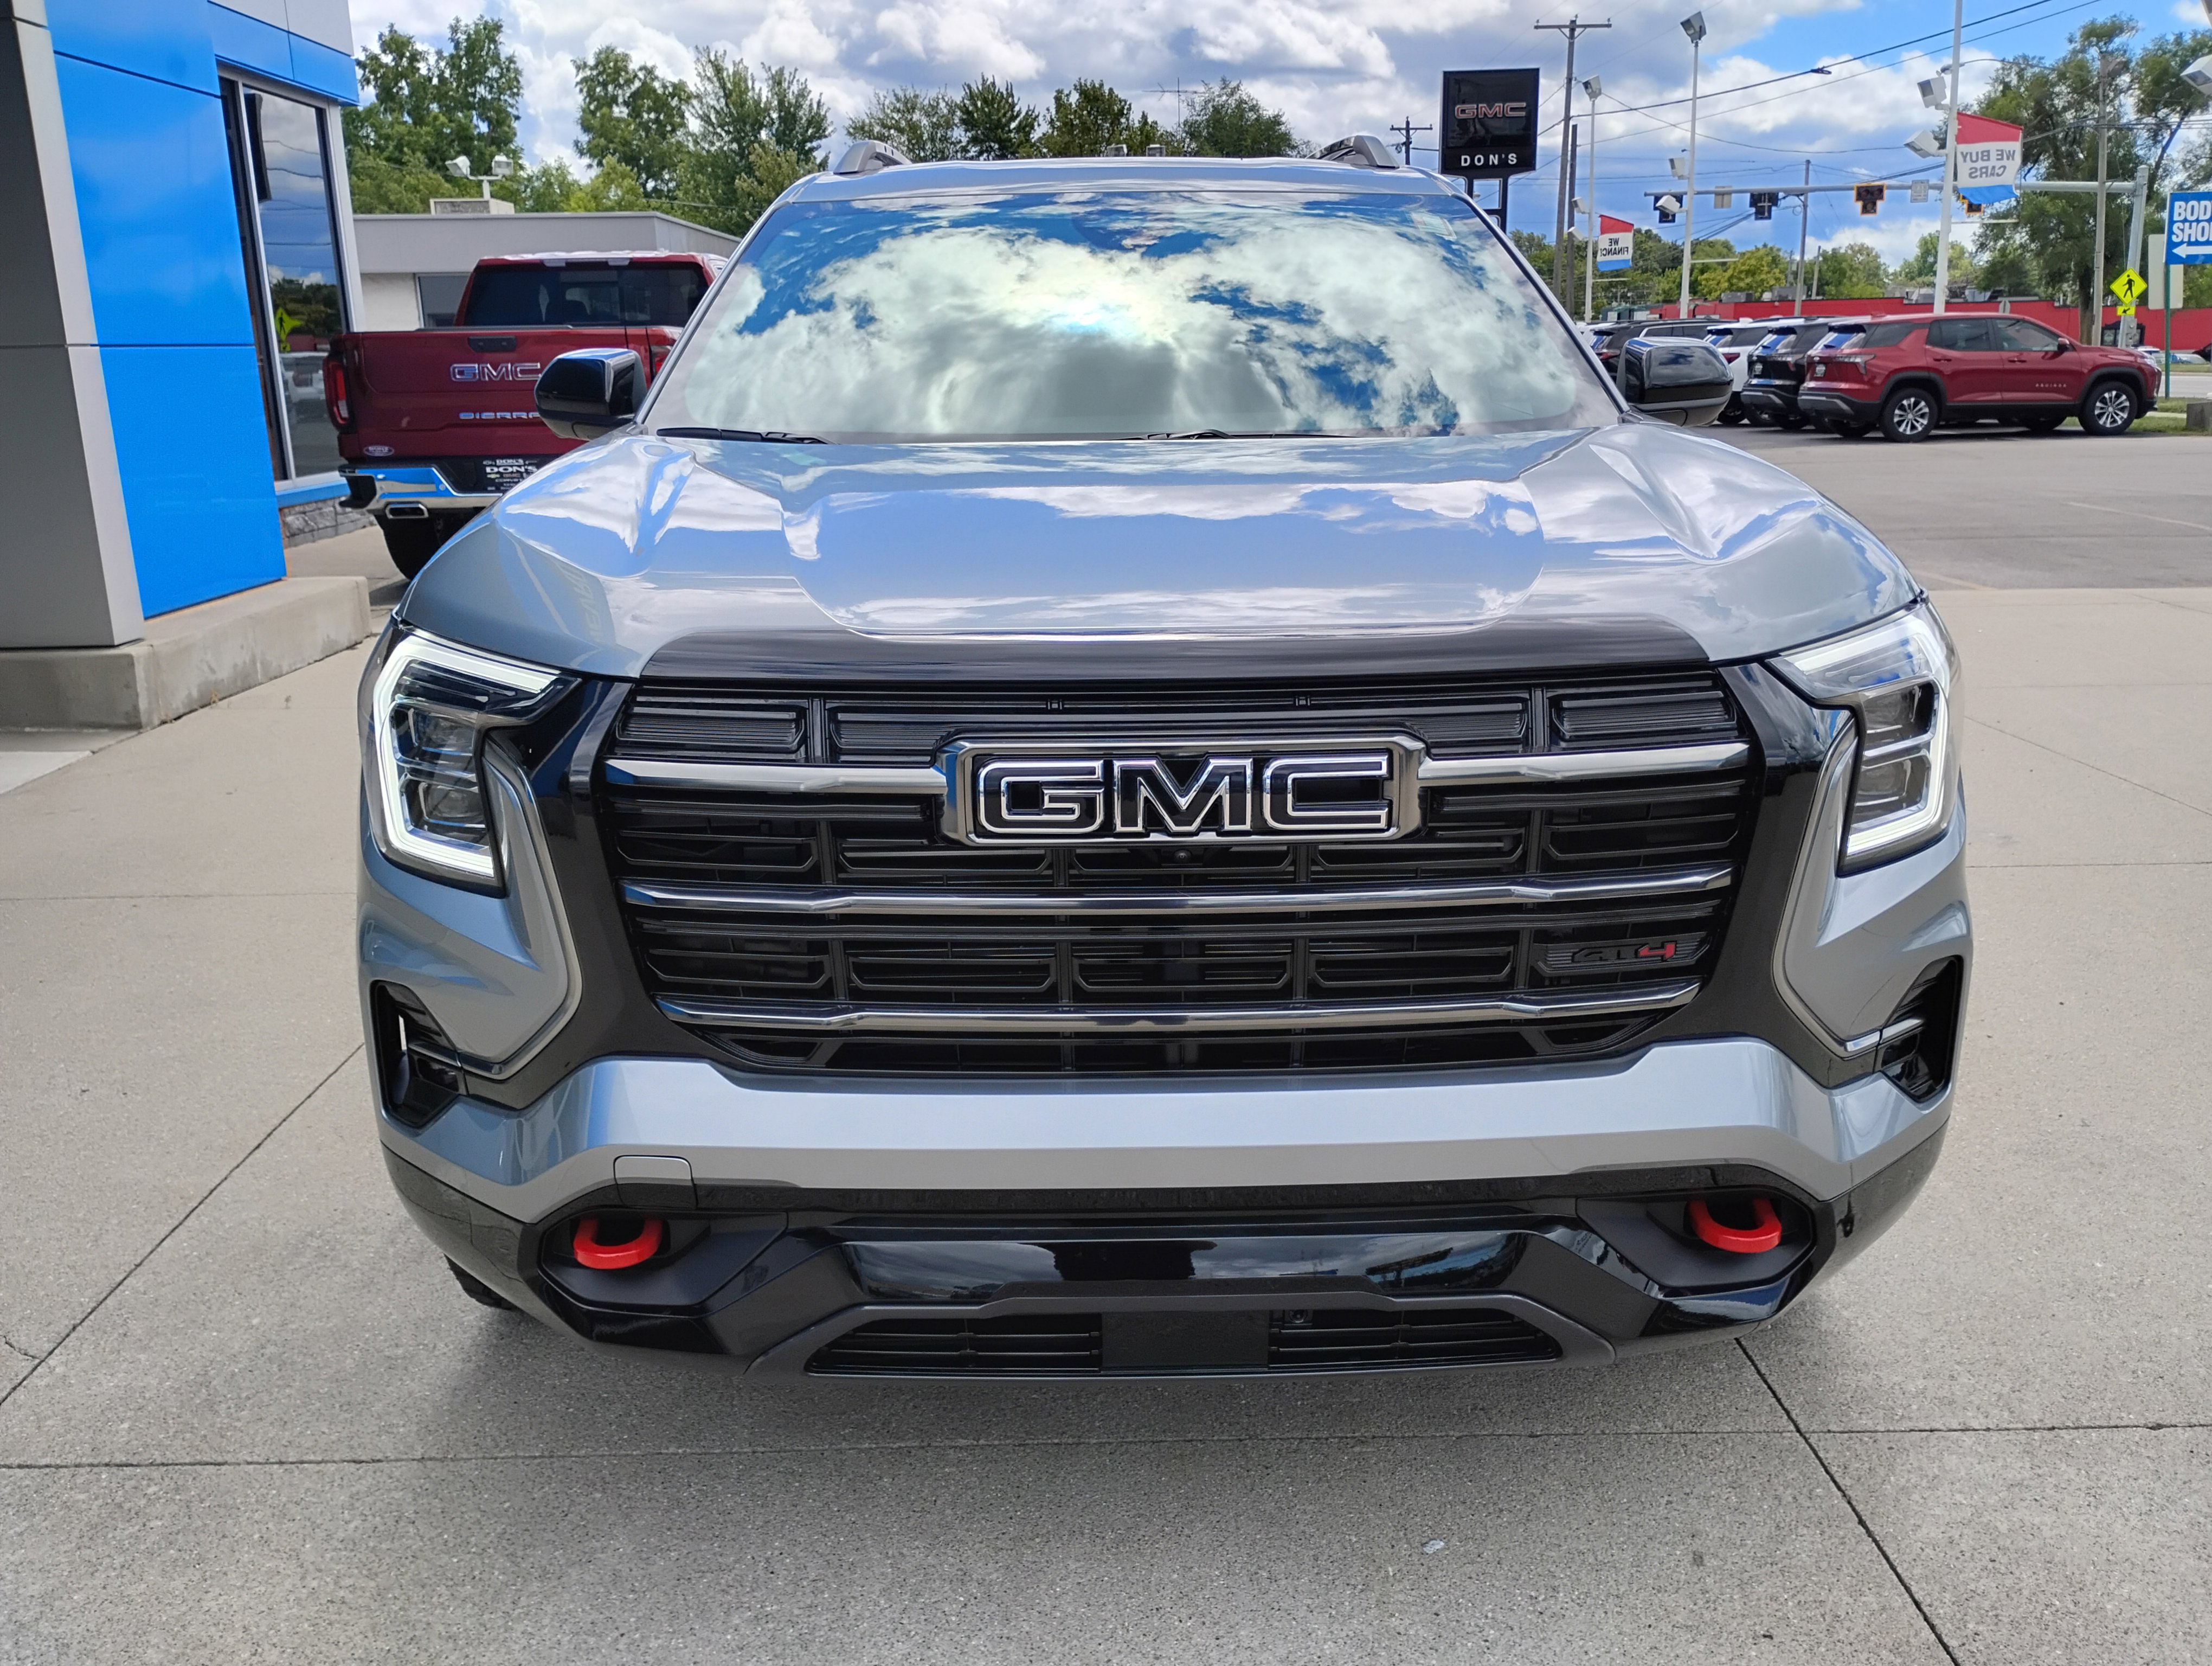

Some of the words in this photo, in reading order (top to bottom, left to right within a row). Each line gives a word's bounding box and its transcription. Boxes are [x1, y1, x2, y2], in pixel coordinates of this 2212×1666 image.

[1455, 102, 1526, 119] GMC
[1461, 153, 1517, 166] DON'S
[2173, 200, 2212, 221] BOD
[2171, 221, 2212, 242] SHO
[451, 362, 541, 381] GMC
[978, 754, 1389, 833] GMC
